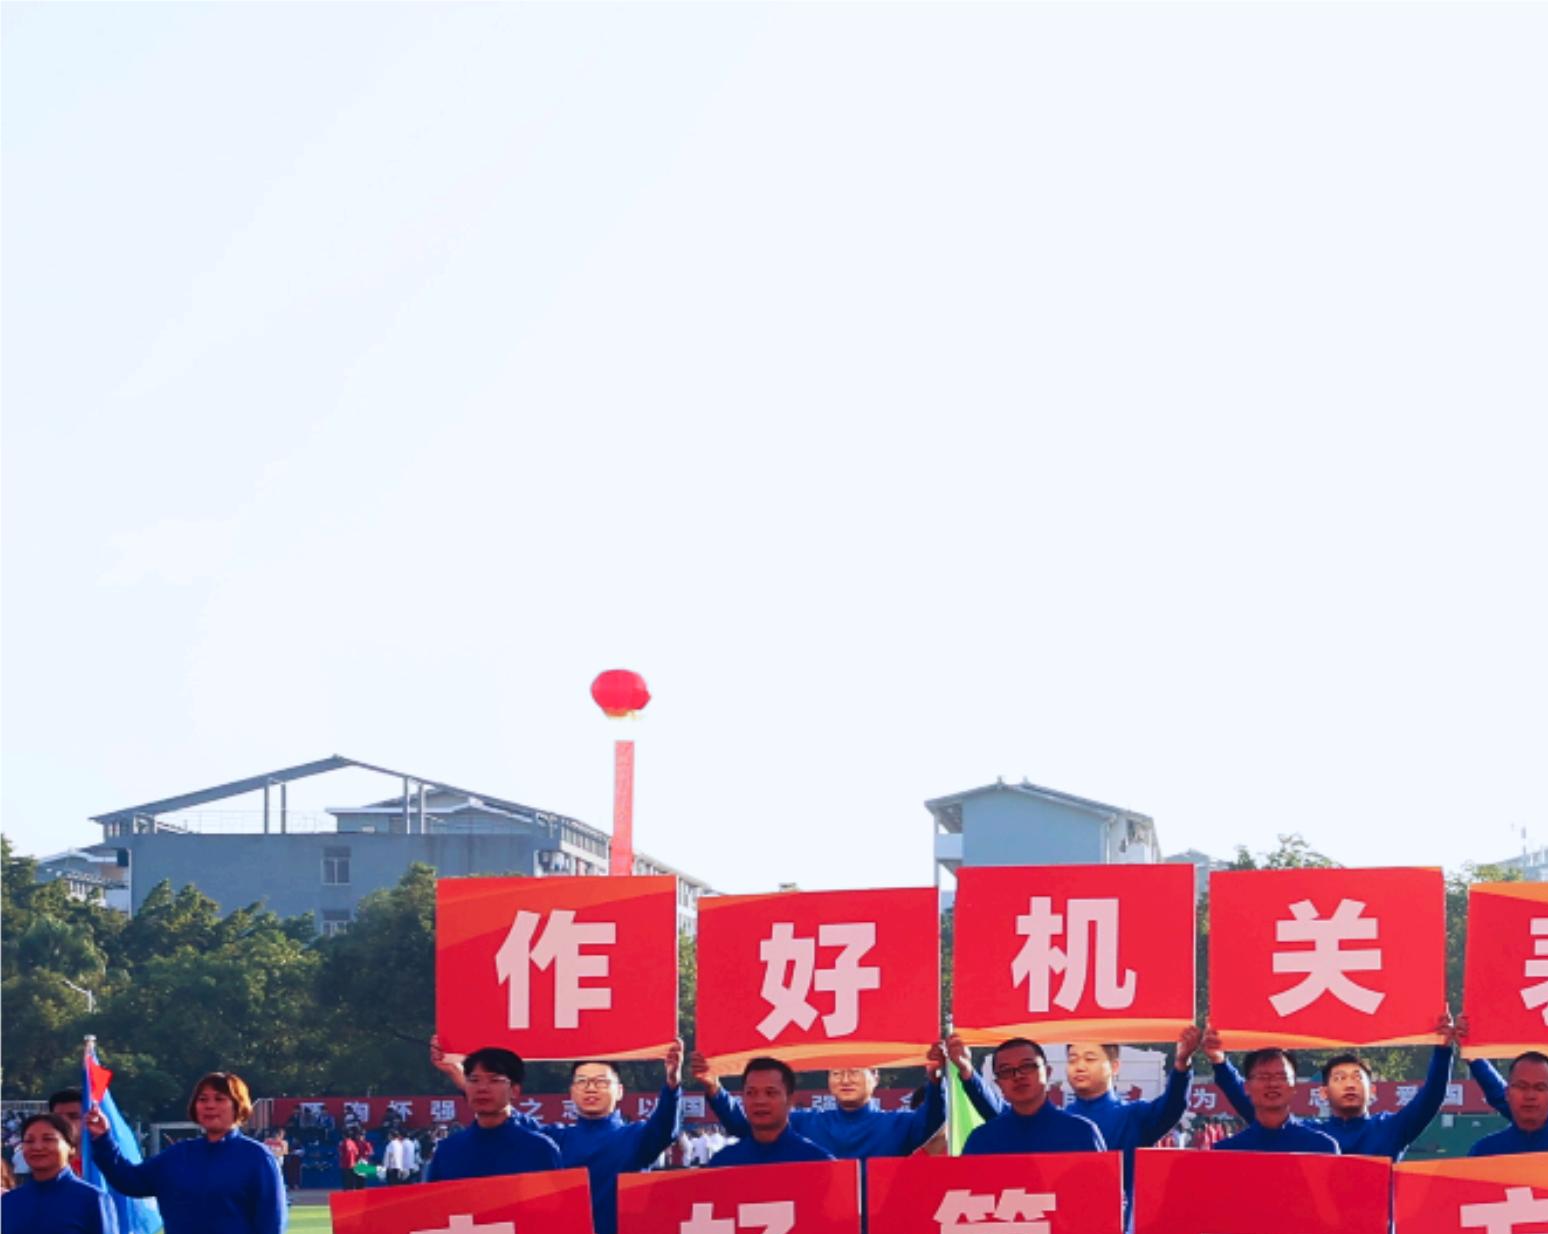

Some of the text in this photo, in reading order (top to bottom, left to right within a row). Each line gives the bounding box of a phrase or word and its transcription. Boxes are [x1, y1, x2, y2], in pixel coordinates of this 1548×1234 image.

[496, 910, 615, 1028] 作
[757, 923, 879, 1040] 好
[1012, 897, 1136, 1012] 机
[1270, 899, 1384, 1016] 关
